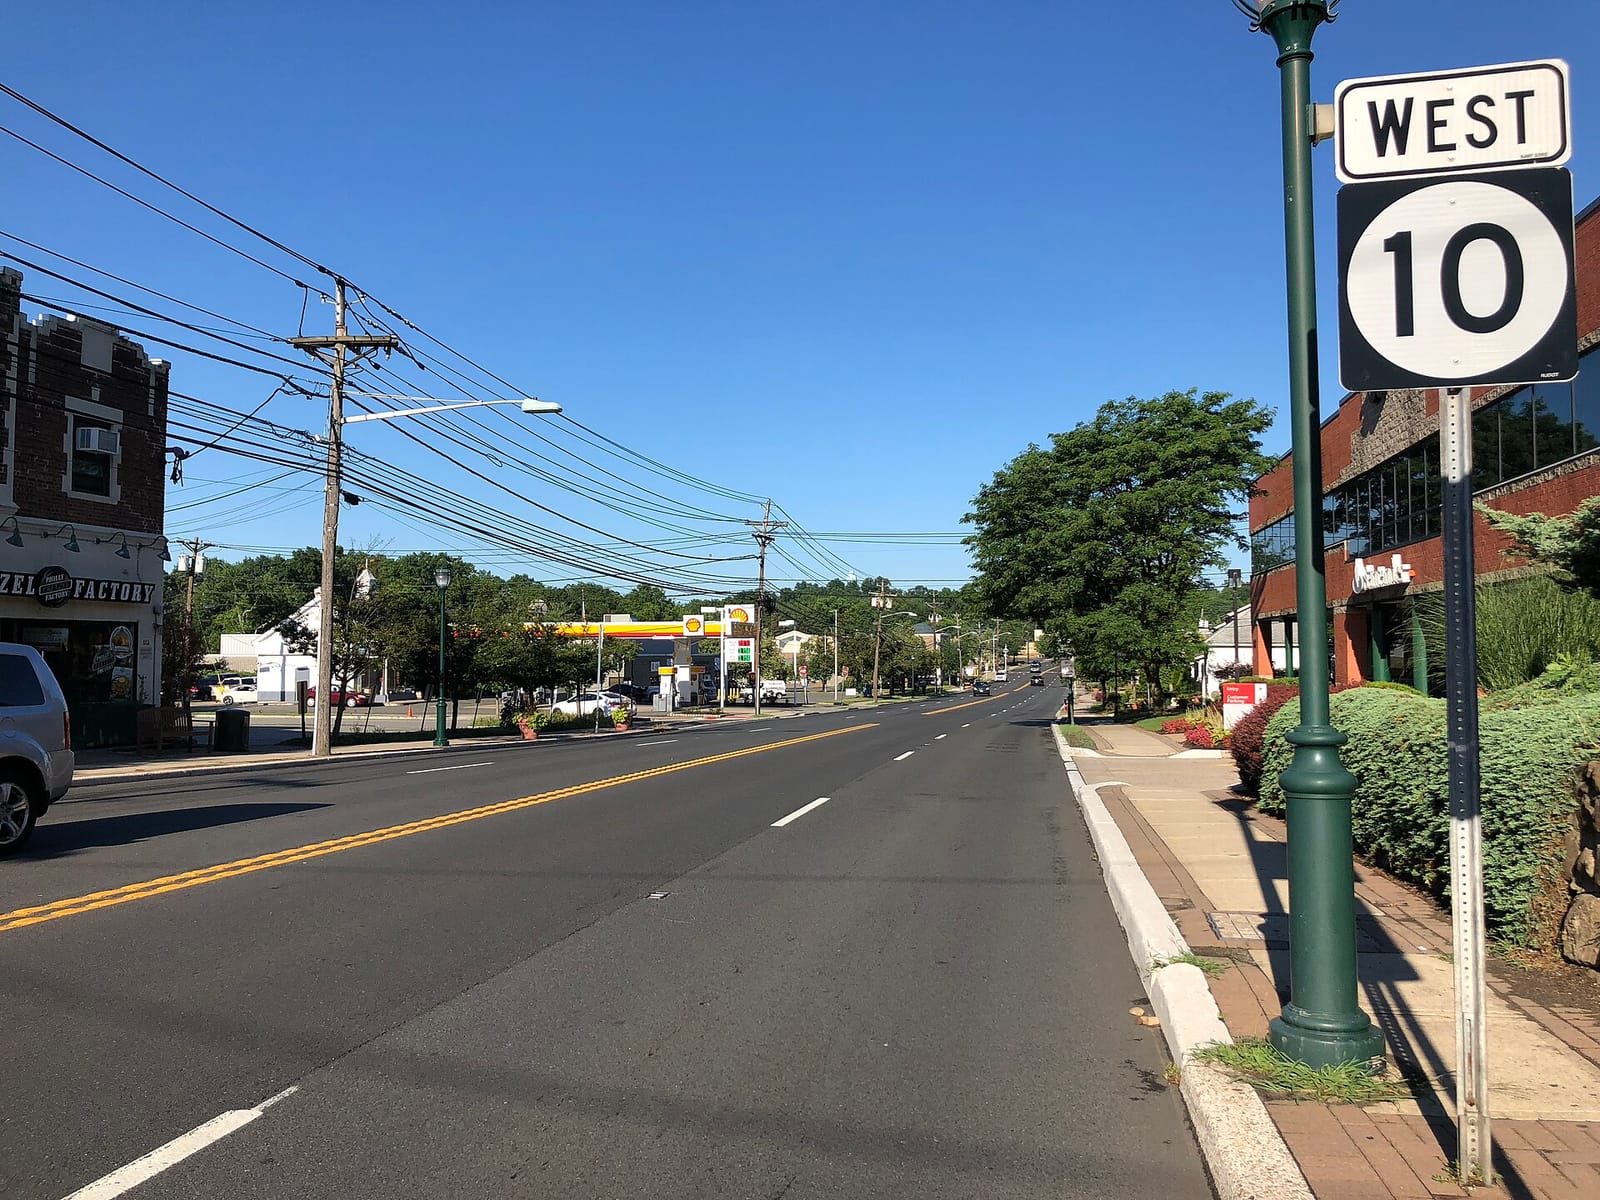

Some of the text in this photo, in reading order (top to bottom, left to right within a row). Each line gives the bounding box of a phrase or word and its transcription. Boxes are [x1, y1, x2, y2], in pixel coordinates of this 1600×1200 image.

[1367, 90, 1535, 158] WEST
[1383, 222, 1525, 338] 10
[0, 573, 35, 595] ZEL
[73, 579, 154, 602] FACTORY
